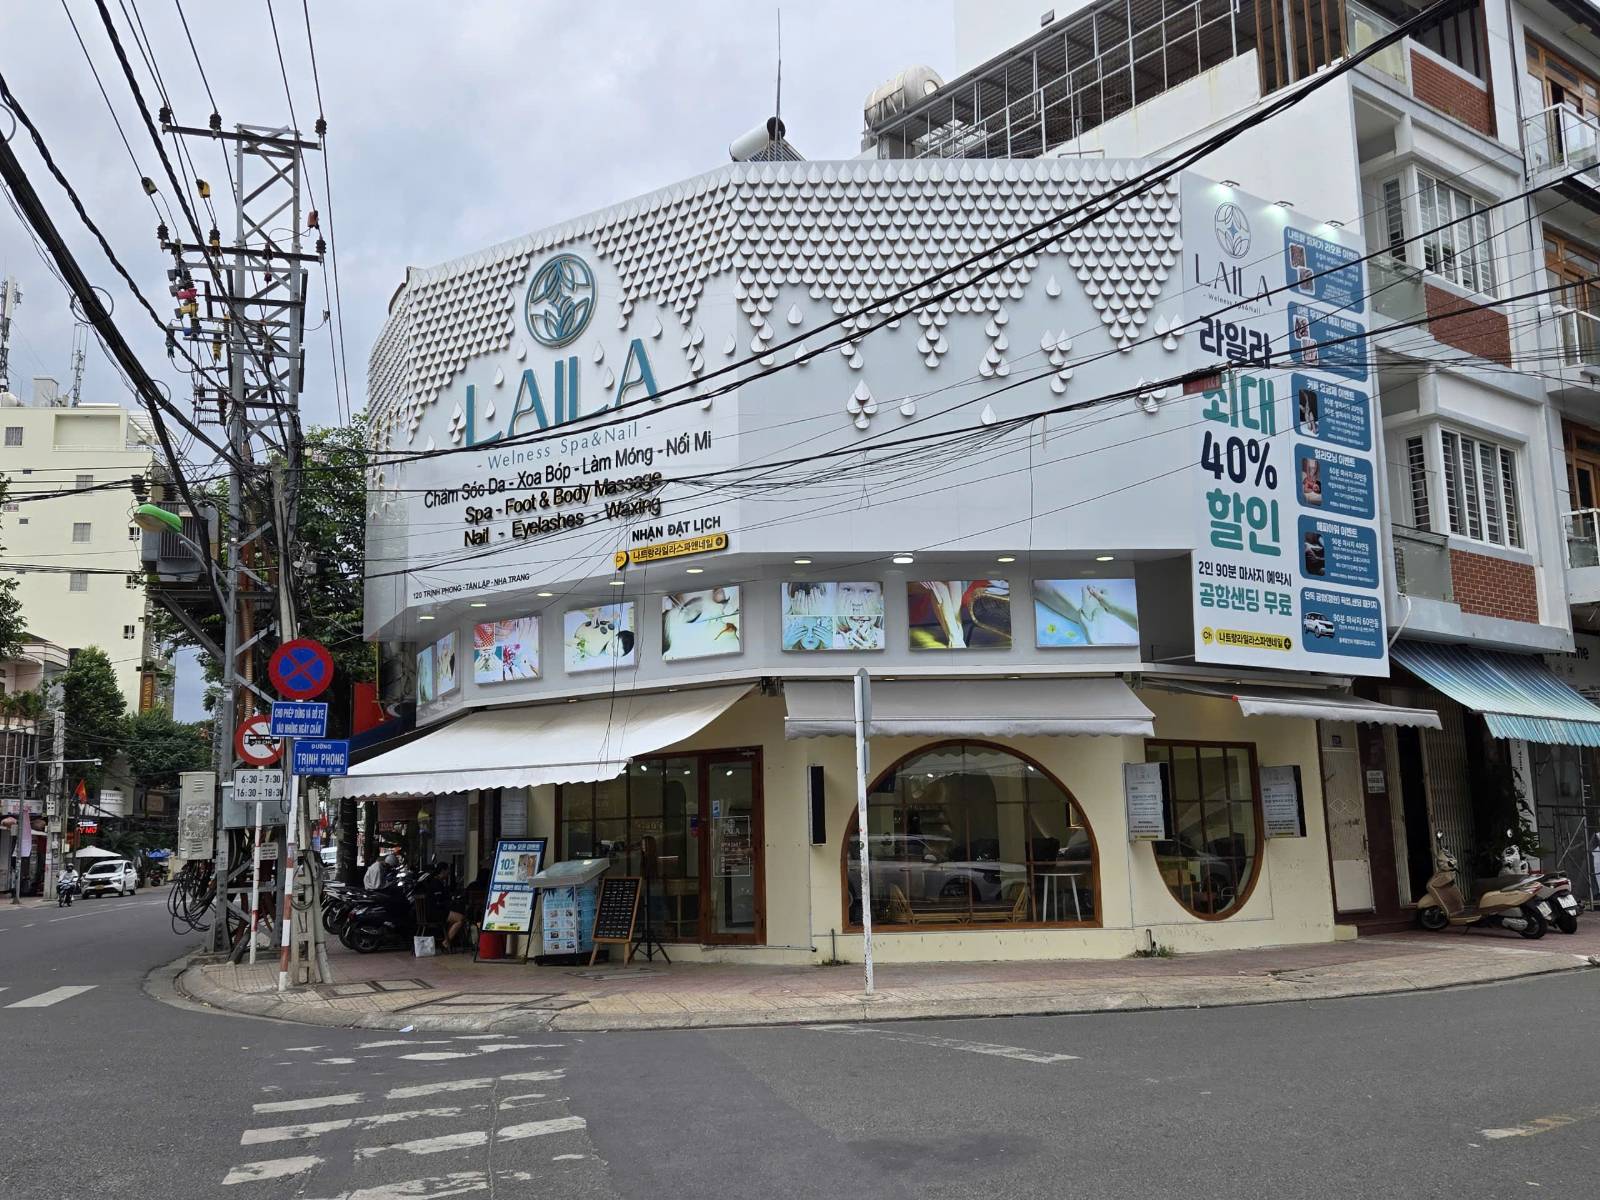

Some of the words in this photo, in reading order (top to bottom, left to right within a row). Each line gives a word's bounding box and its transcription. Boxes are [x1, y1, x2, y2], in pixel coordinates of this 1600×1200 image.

[1195, 253, 1272, 306] LAILA
[1200, 316, 1272, 369] 라일라
[465, 338, 663, 448] LAILA
[1202, 370, 1276, 435] 최대
[462, 481, 485, 501] Sóc
[488, 478, 506, 495] Da
[517, 470, 542, 488] Xoa
[545, 462, 571, 483] Bóp
[582, 454, 612, 475] Làm
[615, 447, 653, 466] Móng
[666, 432, 690, 457] Nối
[694, 430, 712, 452] Mi
[488, 446, 550, 470] Welness
[561, 421, 637, 456] Spa&Nail
[1200, 430, 1277, 490] 40%
[1314, 449, 1338, 464] 얼리모닝
[1338, 454, 1355, 468] 이벤트
[464, 506, 493, 525] Spa
[505, 494, 537, 515] Foot
[539, 490, 550, 508] &
[553, 483, 592, 506] Body
[594, 471, 662, 498] Massage
[464, 527, 489, 547] Nail
[512, 512, 585, 538] Eyelashes
[605, 497, 662, 520] Waxing
[1206, 487, 1281, 557] 할인
[667, 520, 690, 537] ĐẶT
[693, 515, 721, 533] LỊCH
[1340, 526, 1358, 538] 이벤트
[413, 591, 423, 599] 120
[441, 585, 462, 594] PHONG
[494, 577, 506, 586] NHA
[508, 573, 530, 583] TRANG
[1198, 561, 1213, 576] 2인
[1215, 563, 1237, 579] 90분
[1239, 566, 1264, 583] 마사지
[1266, 570, 1292, 587] 예약시
[1199, 582, 1259, 613] 공항샌딩
[1264, 591, 1292, 616] 무료
[241, 774, 258, 784] 6:30
[265, 774, 280, 784] 7:30
[297, 752, 318, 768] TRỊNH
[320, 753, 345, 766] PHONG
[237, 788, 257, 797] 16:30
